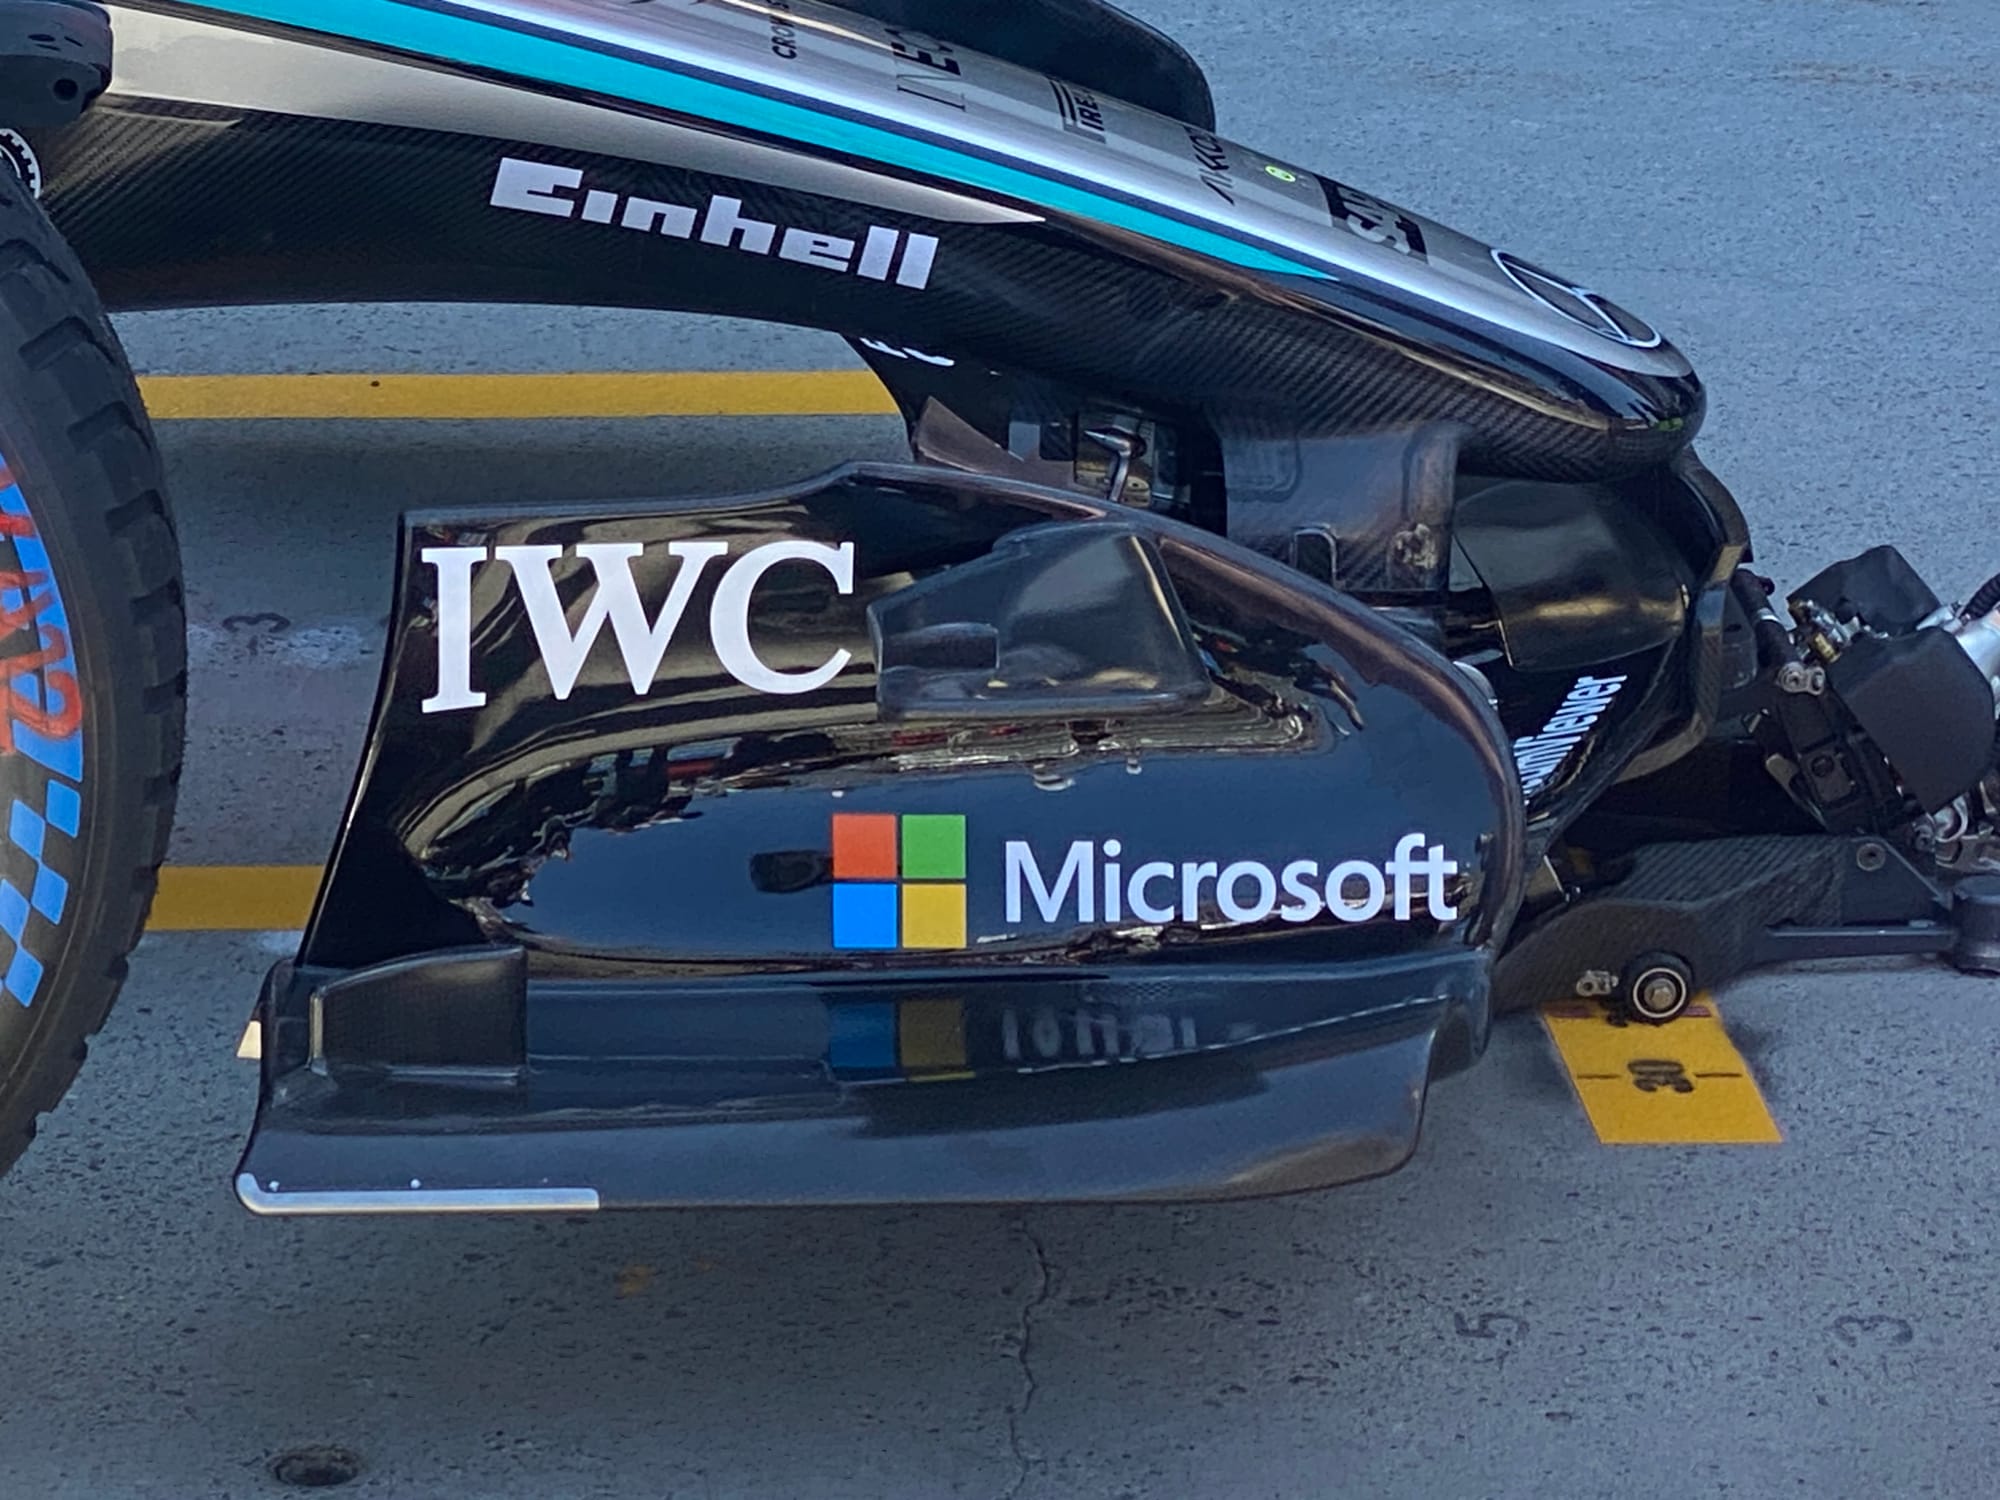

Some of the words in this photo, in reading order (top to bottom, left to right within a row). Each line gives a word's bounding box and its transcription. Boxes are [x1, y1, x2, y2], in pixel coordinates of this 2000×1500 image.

[491, 158, 939, 291] Einhell
[419, 540, 856, 714] IWC
[1004, 833, 1458, 923] Microsoft
